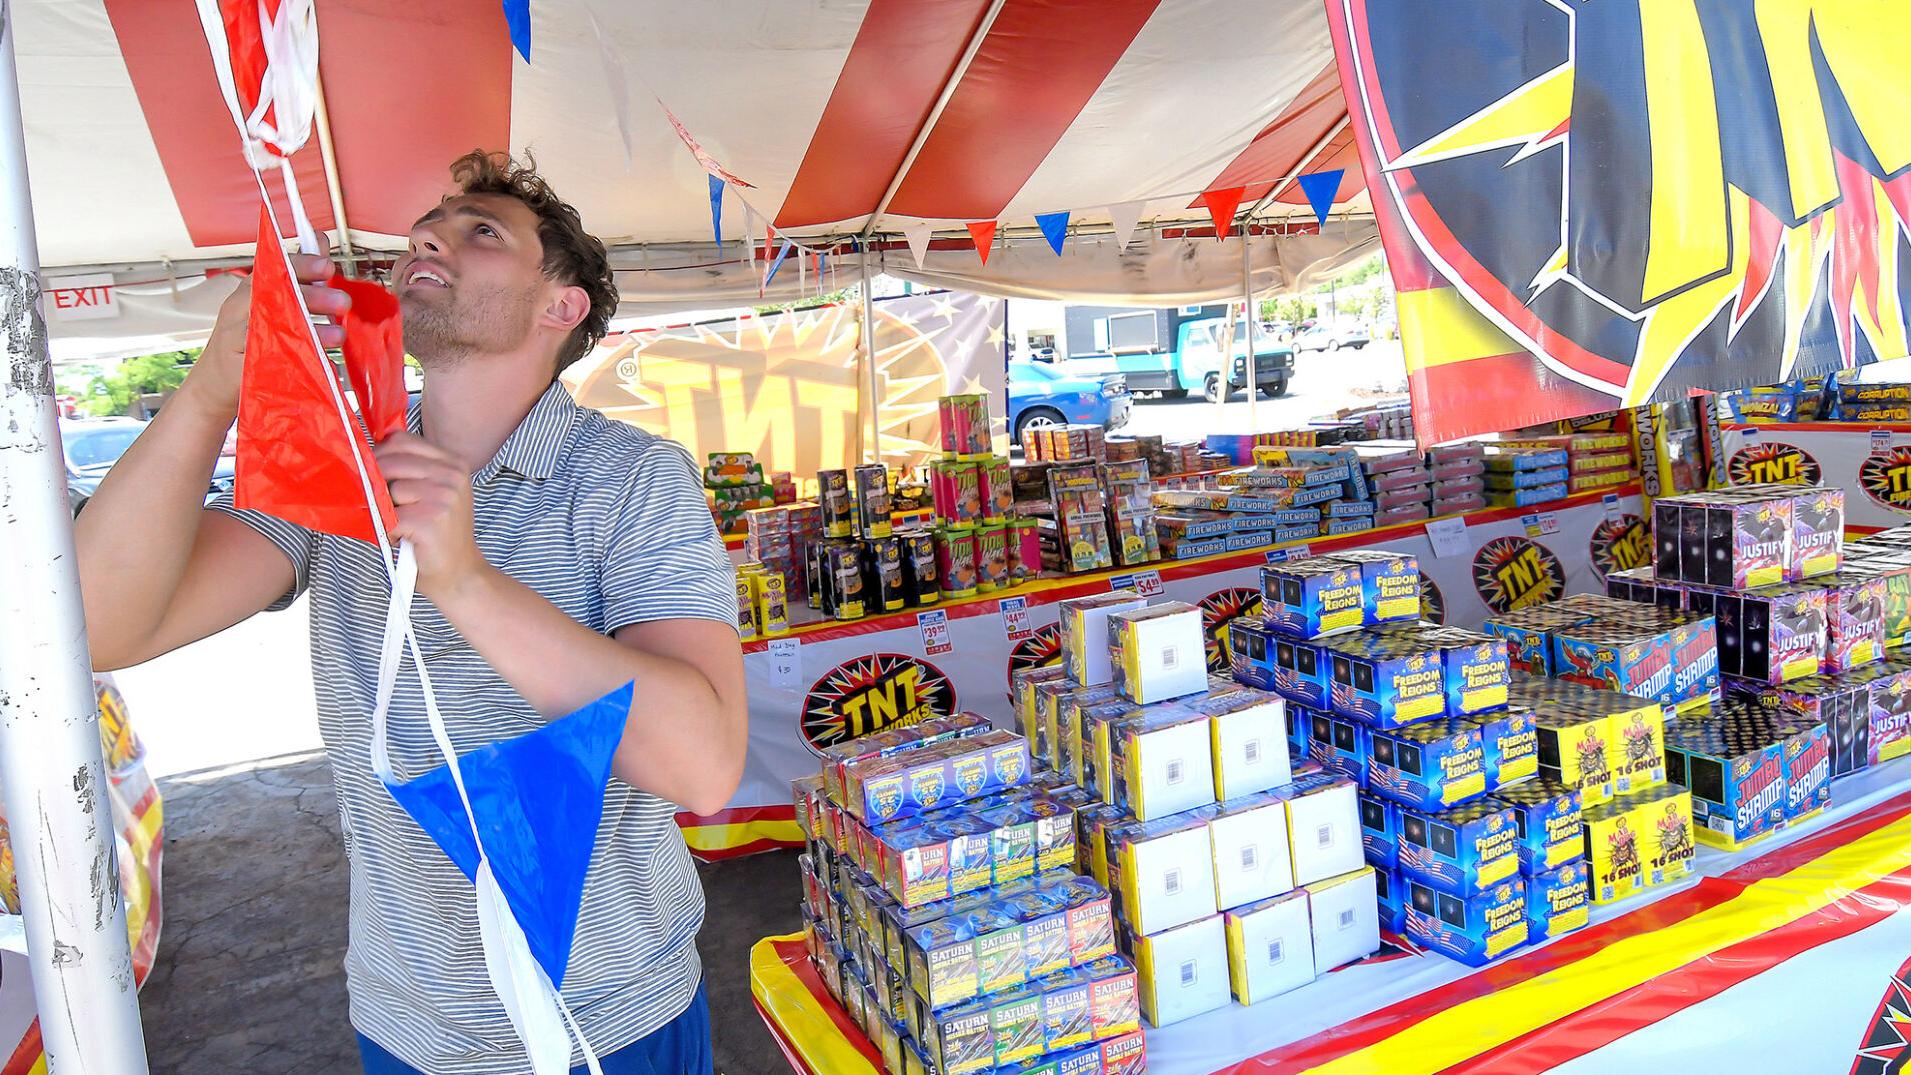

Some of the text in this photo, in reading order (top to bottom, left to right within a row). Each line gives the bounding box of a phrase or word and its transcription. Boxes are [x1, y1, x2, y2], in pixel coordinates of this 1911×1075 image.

[55, 286, 112, 309] EXIT
[1308, 468, 1349, 481] FIREWORKS
[1751, 454, 1801, 483] TNT
[1296, 487, 1340, 503] FIREWORKS
[1230, 501, 1272, 511] FIREWORKS
[1277, 511, 1319, 520] FIREWORKS
[1188, 522, 1232, 535] FIREWORKS
[1234, 519, 1276, 529] FIREWORKS
[1277, 526, 1319, 539] FIREWORKS
[1228, 534, 1271, 547] FIREWORKS
[1799, 530, 1839, 550] JUSTIFY
[1179, 544, 1224, 556] FIREWORKS
[1742, 541, 1786, 559] JUSTIFY
[1376, 575, 1418, 587] FREEDOM
[1498, 546, 1543, 601] TNT
[1319, 585, 1361, 602] FREEDOM
[1382, 586, 1413, 598] REIGNS
[1325, 597, 1357, 611] REIGNS
[1844, 619, 1880, 640] JUSTIFY
[1674, 626, 1715, 673] JUMBO
[1779, 632, 1820, 652] JUSTIFY
[1462, 661, 1506, 676] FREEDOM
[1626, 640, 1670, 691] JUMBO
[1675, 647, 1718, 693] SHRIMP
[1393, 670, 1440, 688] FREEDOM
[1467, 673, 1502, 688] REIGNS
[1399, 681, 1436, 698] REIGNS
[843, 665, 919, 738] TNT
[1498, 730, 1536, 750] FREEDOM
[1440, 747, 1482, 770] FREEDOM
[1503, 742, 1533, 760] REIGNS
[1788, 733, 1828, 783] JUMBO
[1447, 760, 1479, 780] REIGNS
[1615, 756, 1662, 775] 16 SHOT
[1586, 771, 1612, 787] SHOT
[1737, 750, 1781, 807] JUMBO
[1790, 761, 1829, 807] SHRIMP
[1736, 777, 1782, 830] SHRIMP
[1054, 817, 1072, 828] URN
[1545, 811, 1581, 833] FREEDOM
[1011, 828, 1031, 839] URN
[1475, 828, 1516, 852] FREEDOM
[1550, 823, 1580, 842] REIGNS
[968, 838, 988, 849] URN
[1481, 840, 1513, 862] REIGNS
[923, 848, 944, 860] URN
[1651, 847, 1694, 868] 16 SHOT
[1601, 863, 1642, 884] 16 SHOT
[1547, 881, 1588, 903] FREEDOM
[1072, 904, 1110, 920] SATURN
[1485, 897, 1524, 923] FREEDOM
[1552, 894, 1584, 912] REIGNS
[1026, 917, 1066, 936] SATURN
[1490, 910, 1522, 931] REIGNS
[981, 931, 1021, 950] SATURN
[931, 943, 973, 963] SATURN
[1094, 979, 1134, 996] SATURN
[1046, 990, 1087, 1008] SATURN
[996, 1002, 1039, 1021] SATURN
[944, 1014, 989, 1034] SATURN
[1106, 1036, 1143, 1056] SATURN
[1060, 1052, 1100, 1073] SATURN
